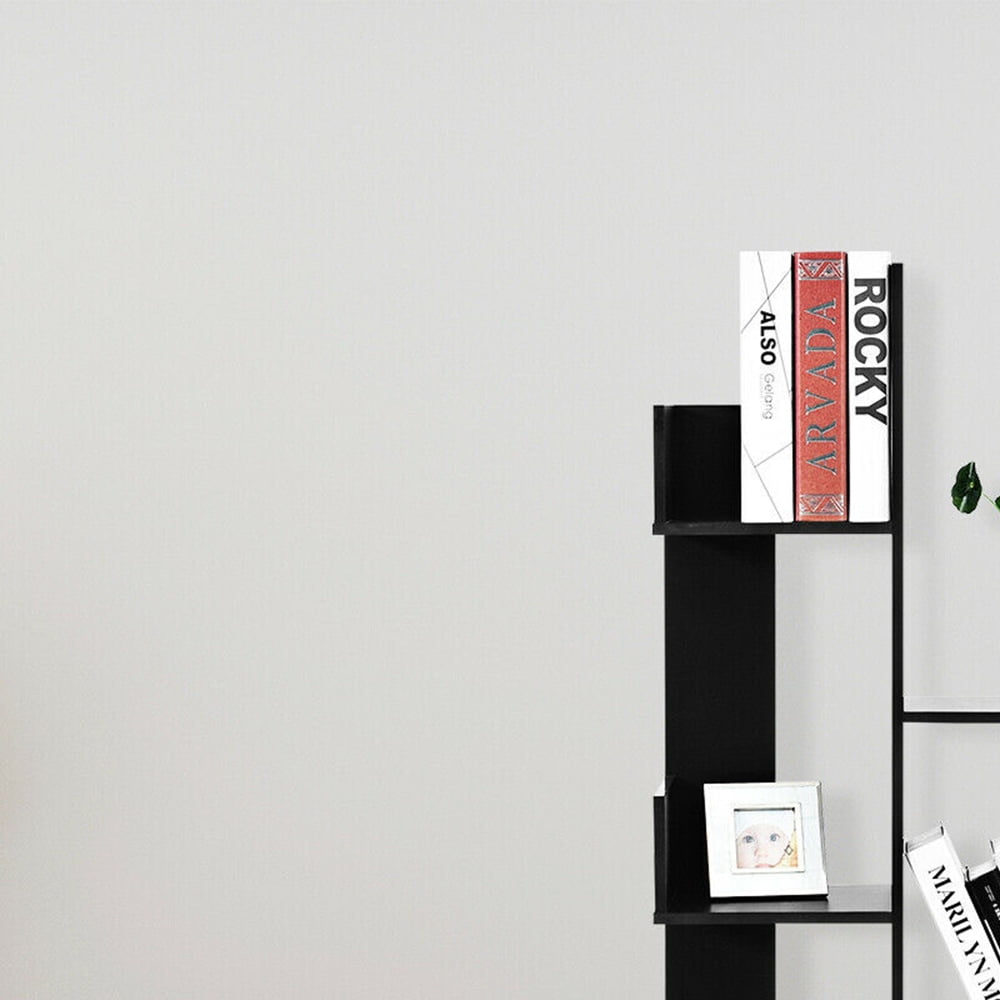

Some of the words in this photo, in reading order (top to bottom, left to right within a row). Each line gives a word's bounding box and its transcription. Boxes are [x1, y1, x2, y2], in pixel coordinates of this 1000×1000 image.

[760, 310, 777, 365] ALSO
[804, 298, 837, 475] ARVADA
[854, 278, 888, 426] ROCKY
[928, 865, 991, 976] MARILYN
